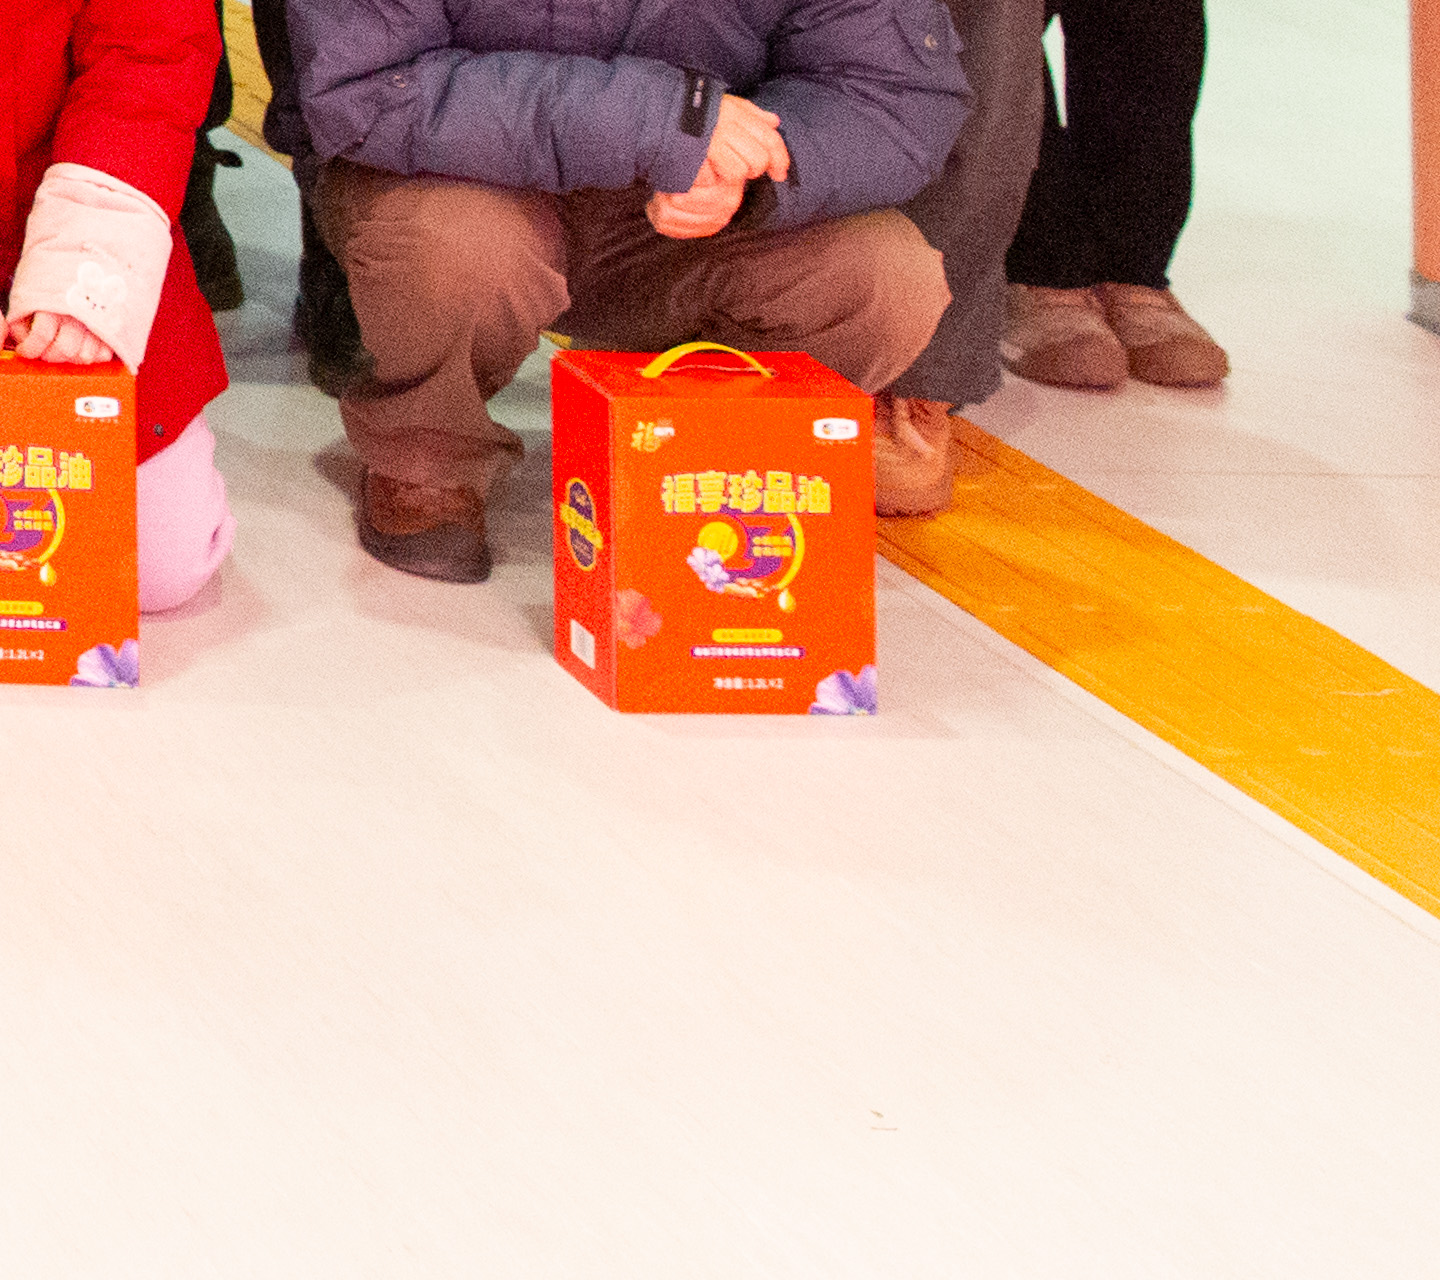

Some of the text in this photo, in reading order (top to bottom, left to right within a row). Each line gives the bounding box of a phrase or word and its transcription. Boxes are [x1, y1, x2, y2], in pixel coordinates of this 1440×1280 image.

[661, 470, 832, 514] 福享珍品油
